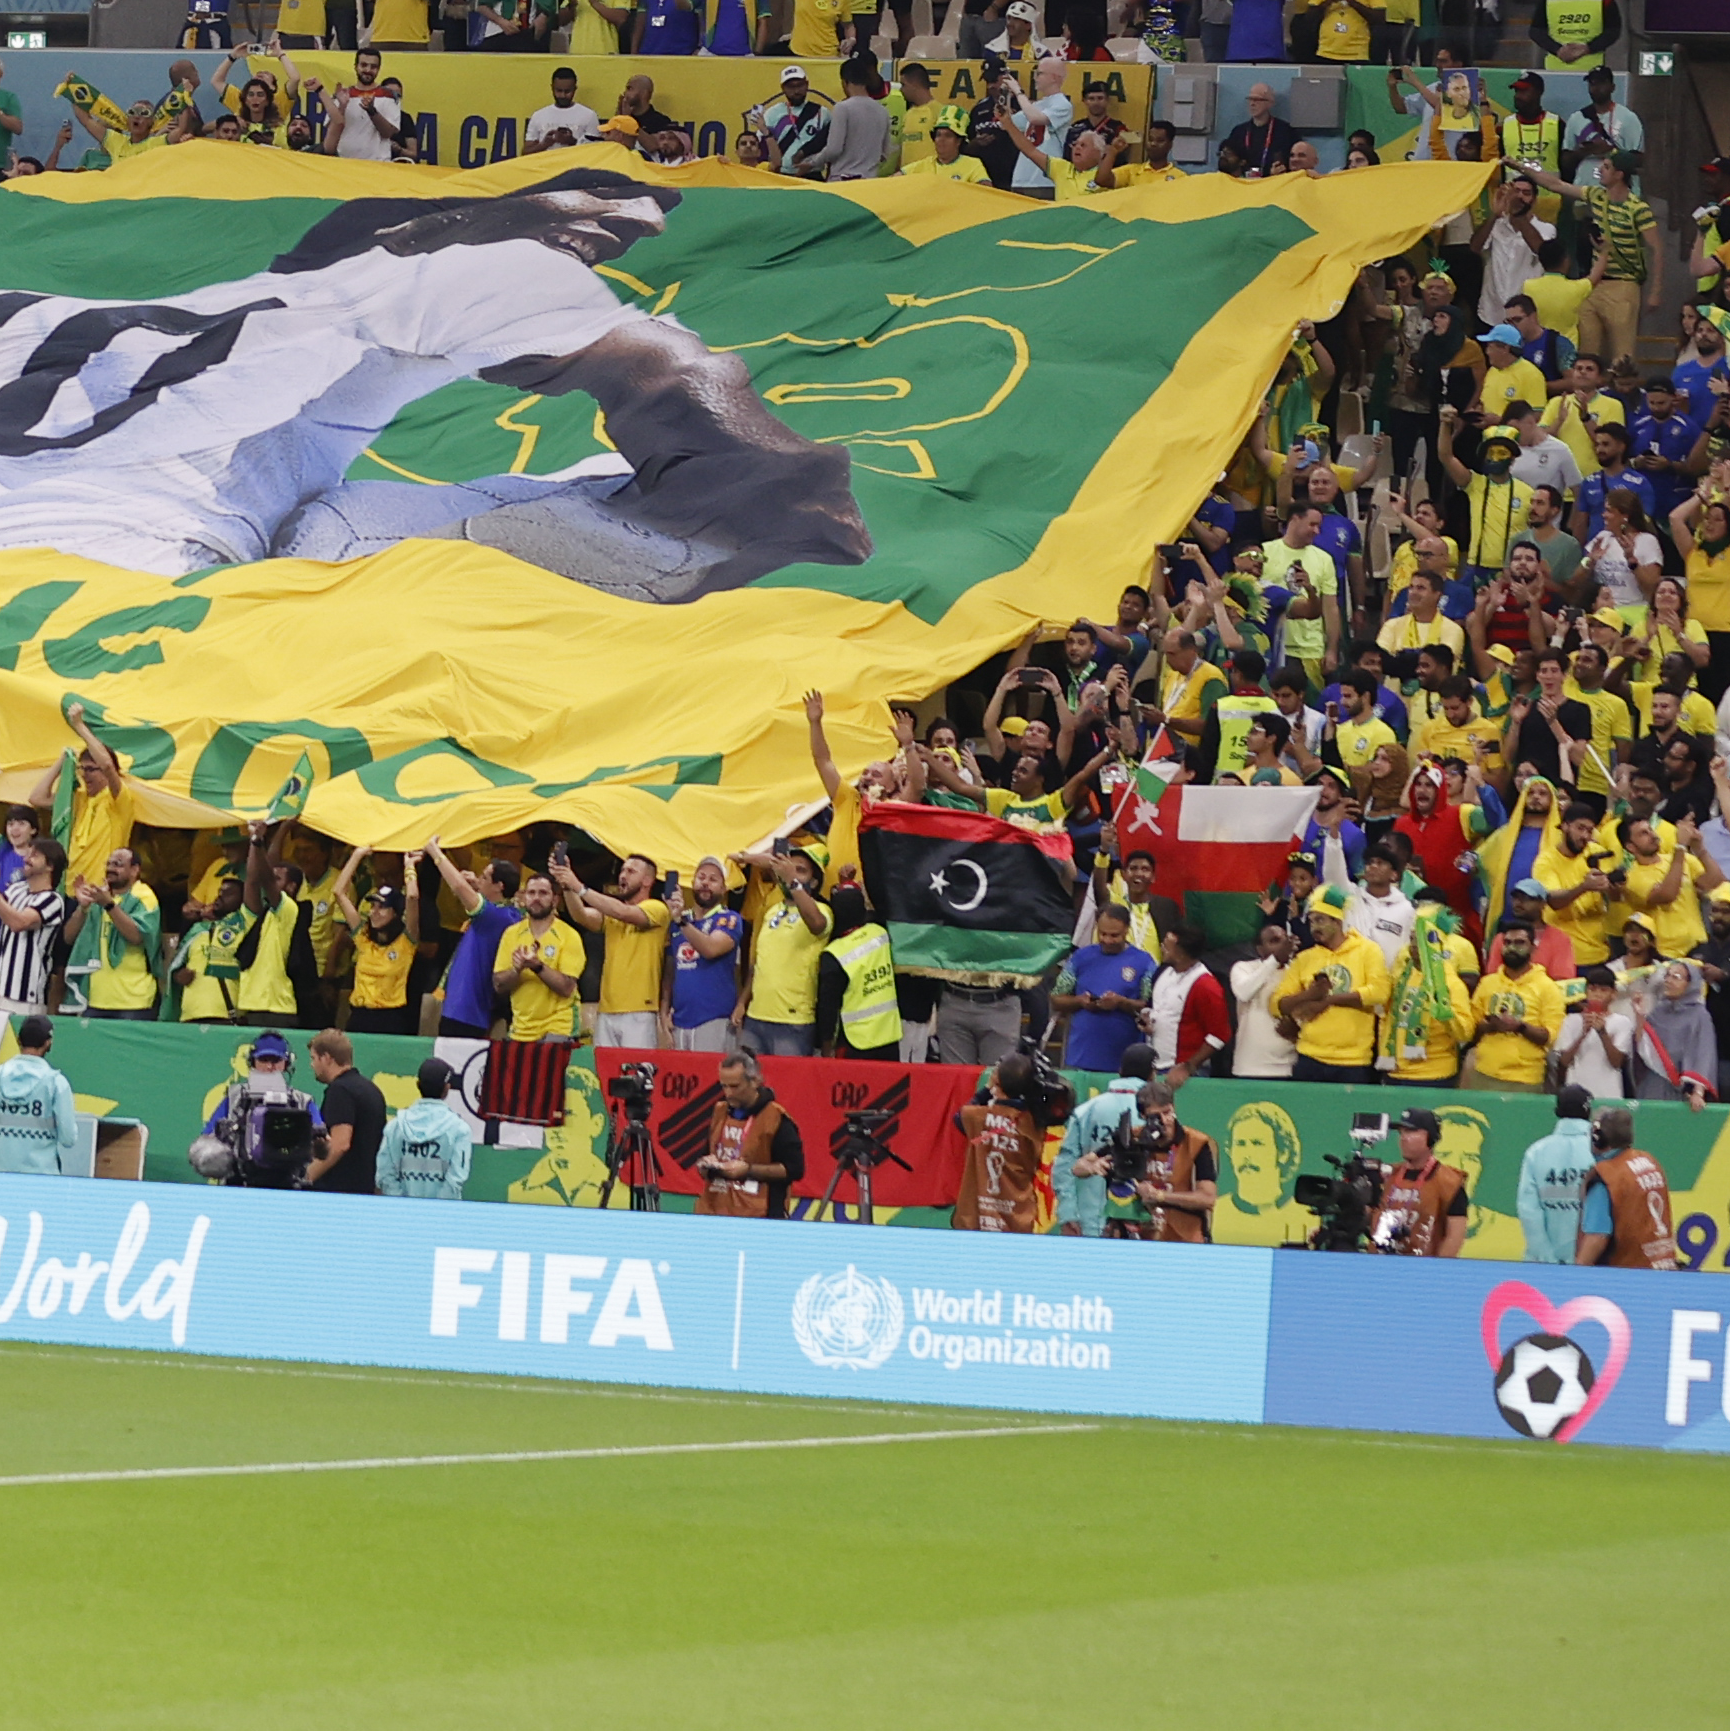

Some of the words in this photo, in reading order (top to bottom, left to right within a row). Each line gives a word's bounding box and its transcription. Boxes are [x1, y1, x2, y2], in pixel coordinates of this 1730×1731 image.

[429, 1246, 674, 1352] FIFA
[912, 1286, 1008, 1325] World
[1012, 1291, 1114, 1332] Health
[908, 1320, 1113, 1371] Organization
